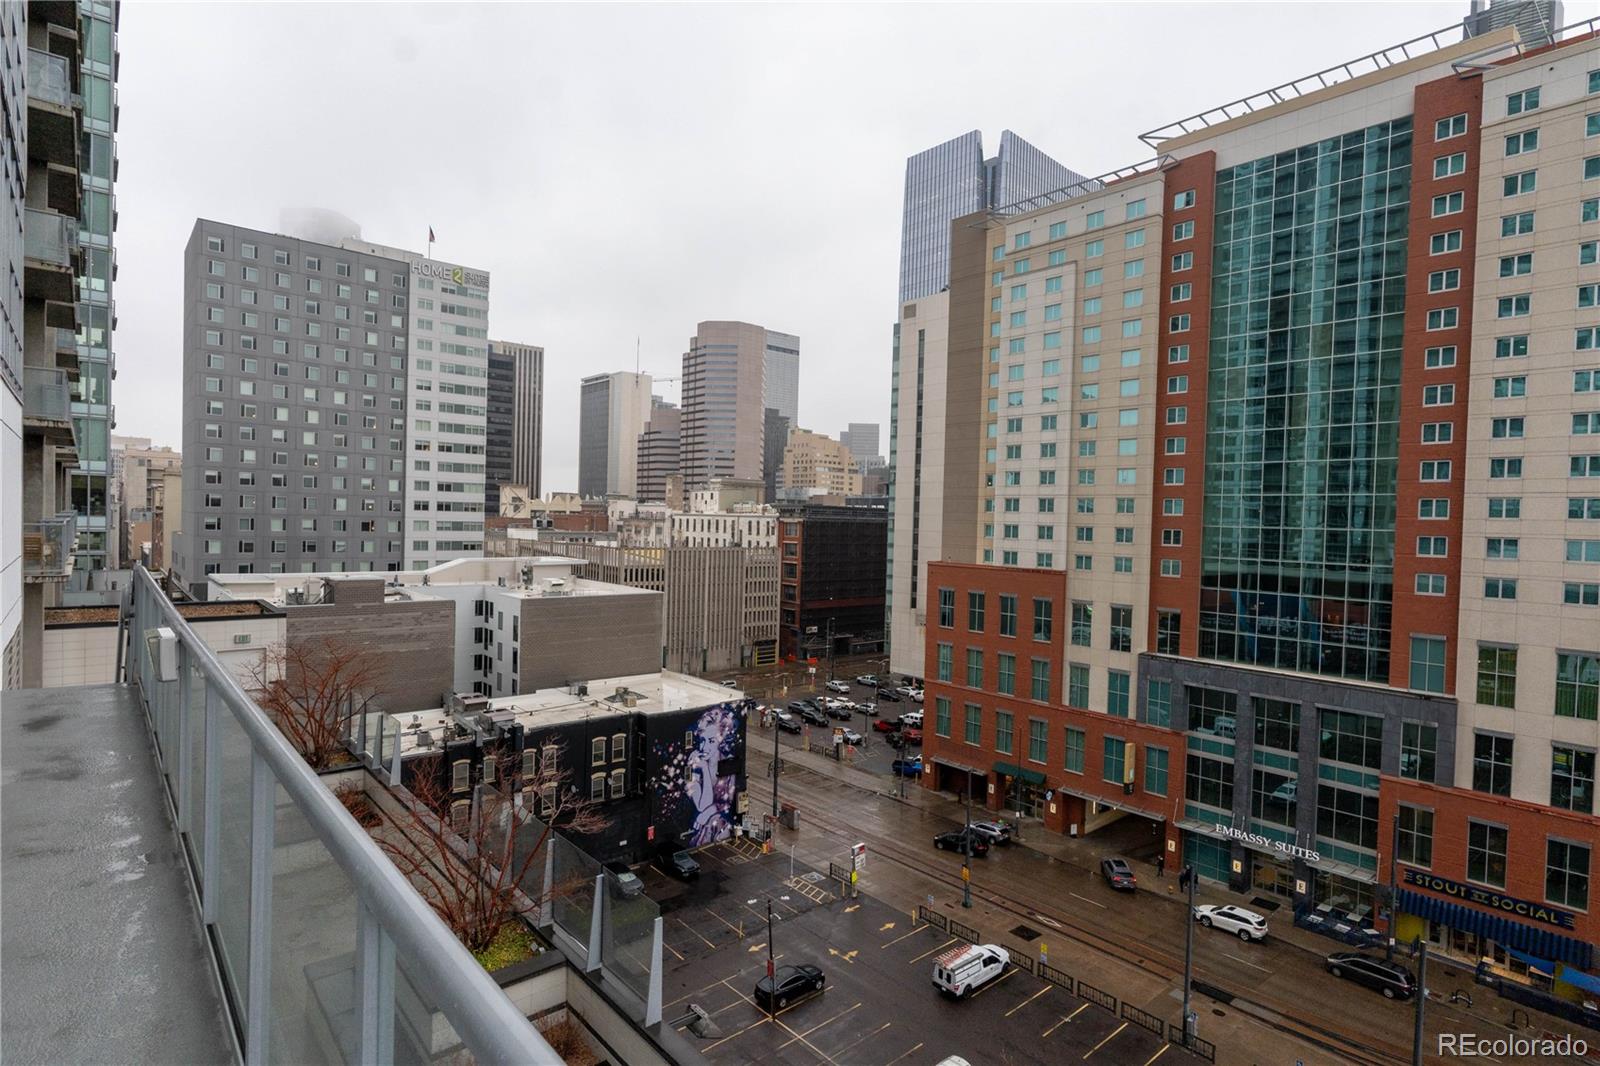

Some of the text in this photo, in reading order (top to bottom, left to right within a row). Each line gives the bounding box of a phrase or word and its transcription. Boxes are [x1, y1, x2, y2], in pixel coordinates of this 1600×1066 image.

[411, 260, 452, 281] HOME
[1215, 823, 1320, 862] EMBASSY SUITES
[1415, 874, 1467, 897] STOUT
[1492, 895, 1560, 923] SOCIAL
